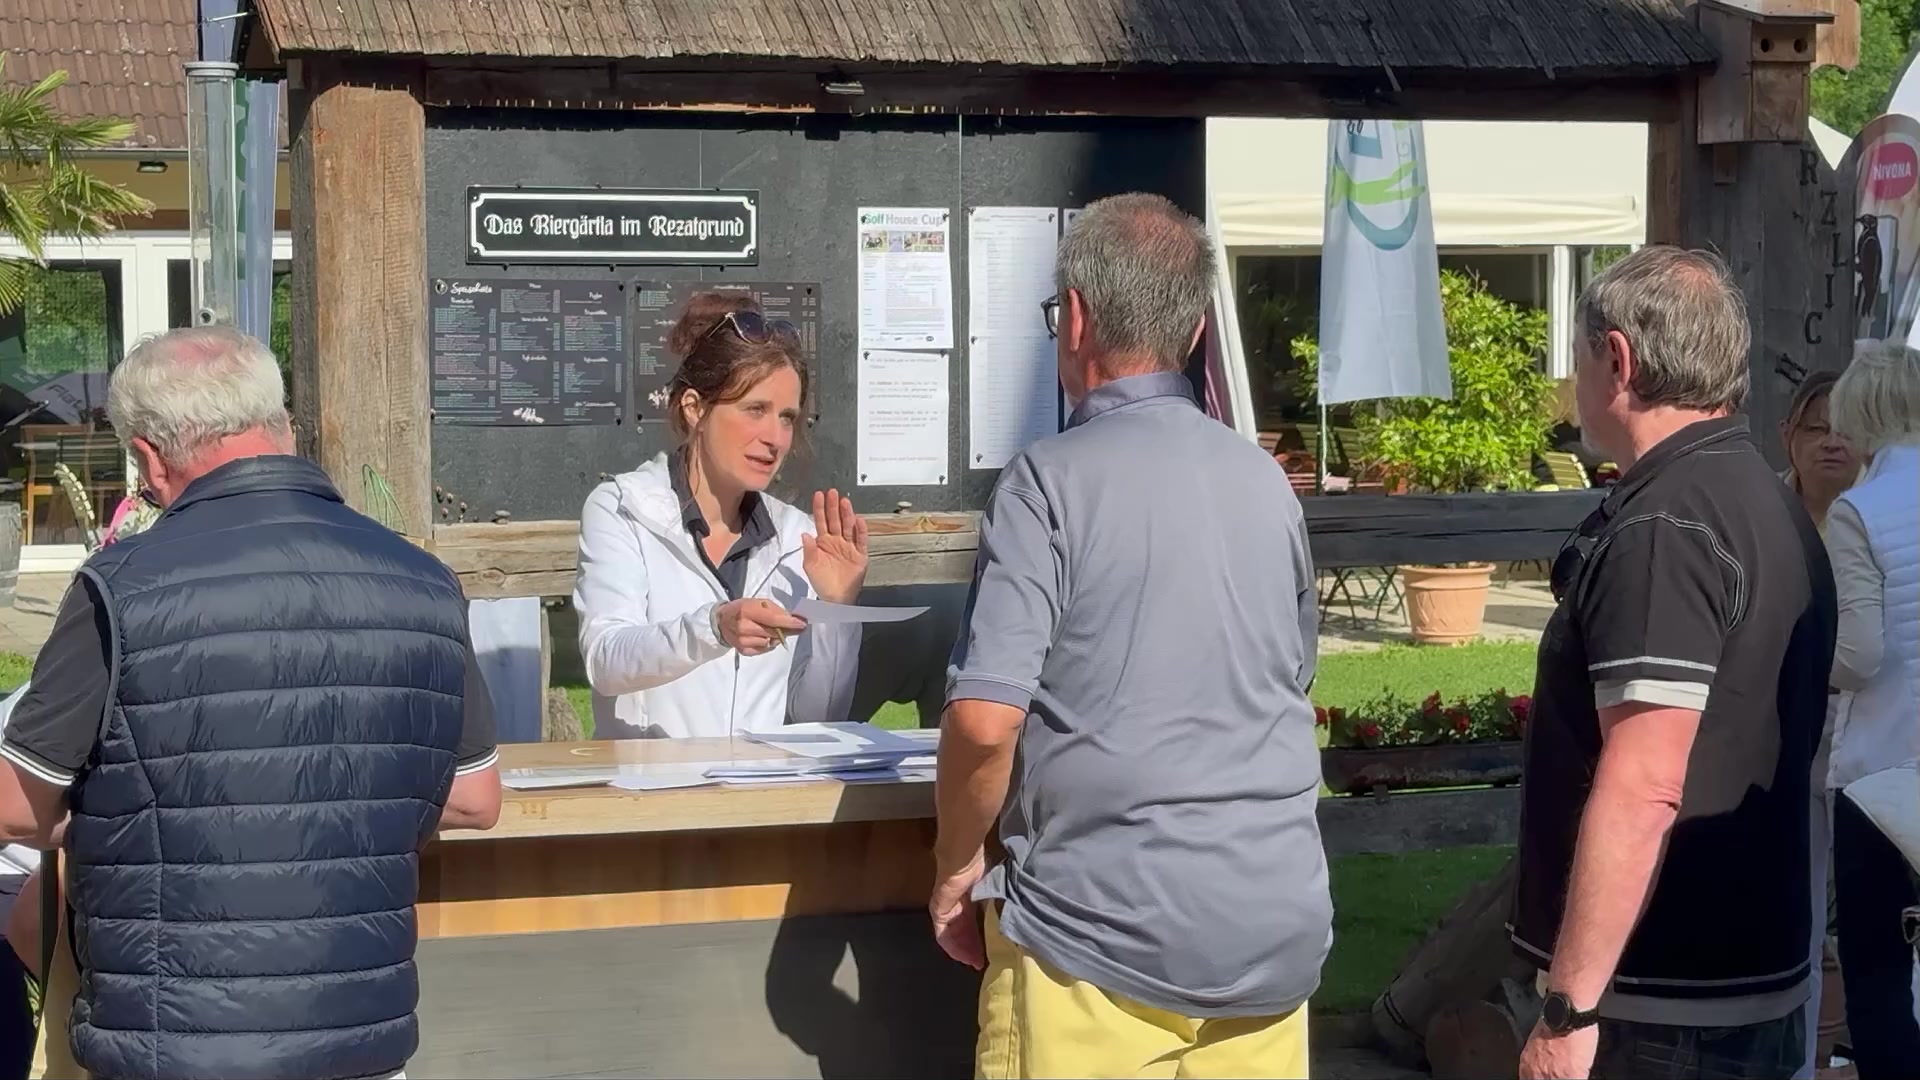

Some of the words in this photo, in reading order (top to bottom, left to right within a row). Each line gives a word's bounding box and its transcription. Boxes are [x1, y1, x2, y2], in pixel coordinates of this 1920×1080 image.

[1871, 161, 1912, 180] NIVONA
[483, 213, 523, 236] Das
[530, 214, 614, 239] Biergärtla
[620, 215, 641, 236] im
[648, 215, 744, 240] Rezatgrund
[863, 213, 885, 225] Golf
[886, 213, 918, 225] House
[921, 213, 945, 227] Cup
